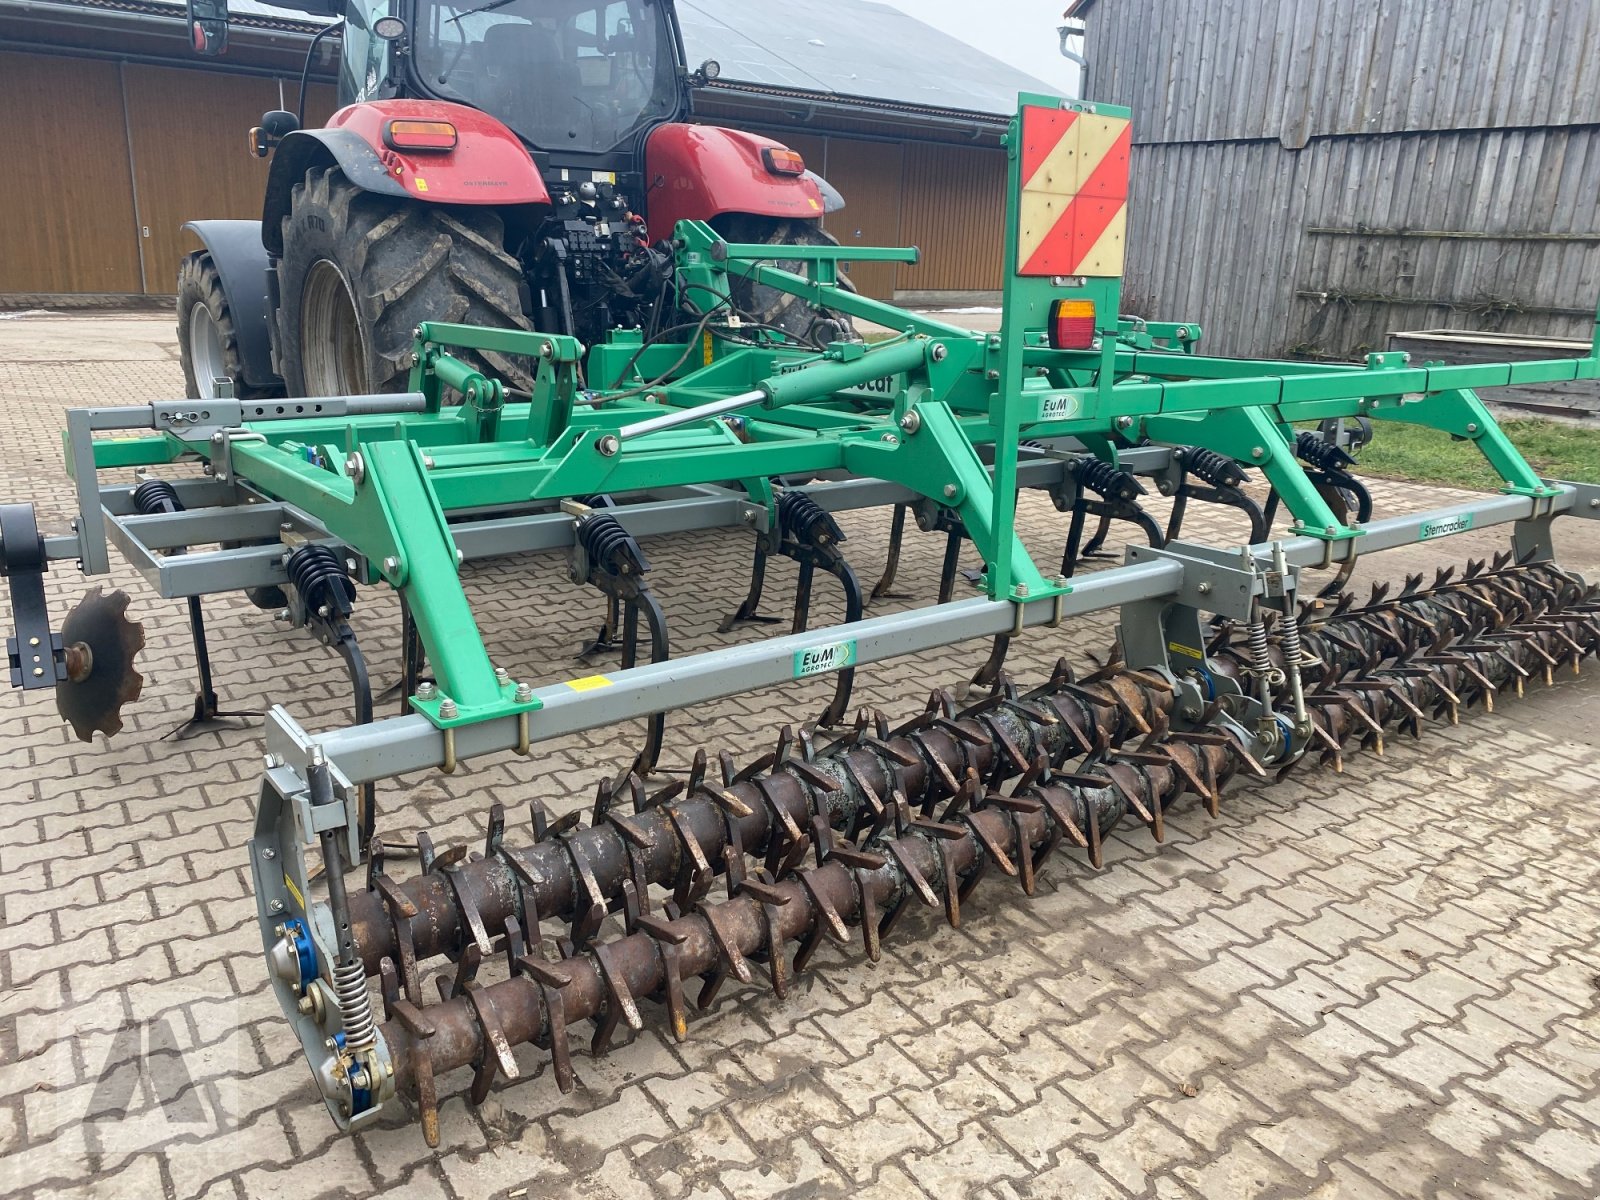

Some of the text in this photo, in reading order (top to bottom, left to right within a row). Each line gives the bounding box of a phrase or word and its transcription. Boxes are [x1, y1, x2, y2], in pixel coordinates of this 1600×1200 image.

[1043, 398, 1067, 411] EuM
[1424, 516, 1469, 537] Sterncracker
[803, 647, 834, 666] EuM
[801, 661, 832, 673] AGROTEC
